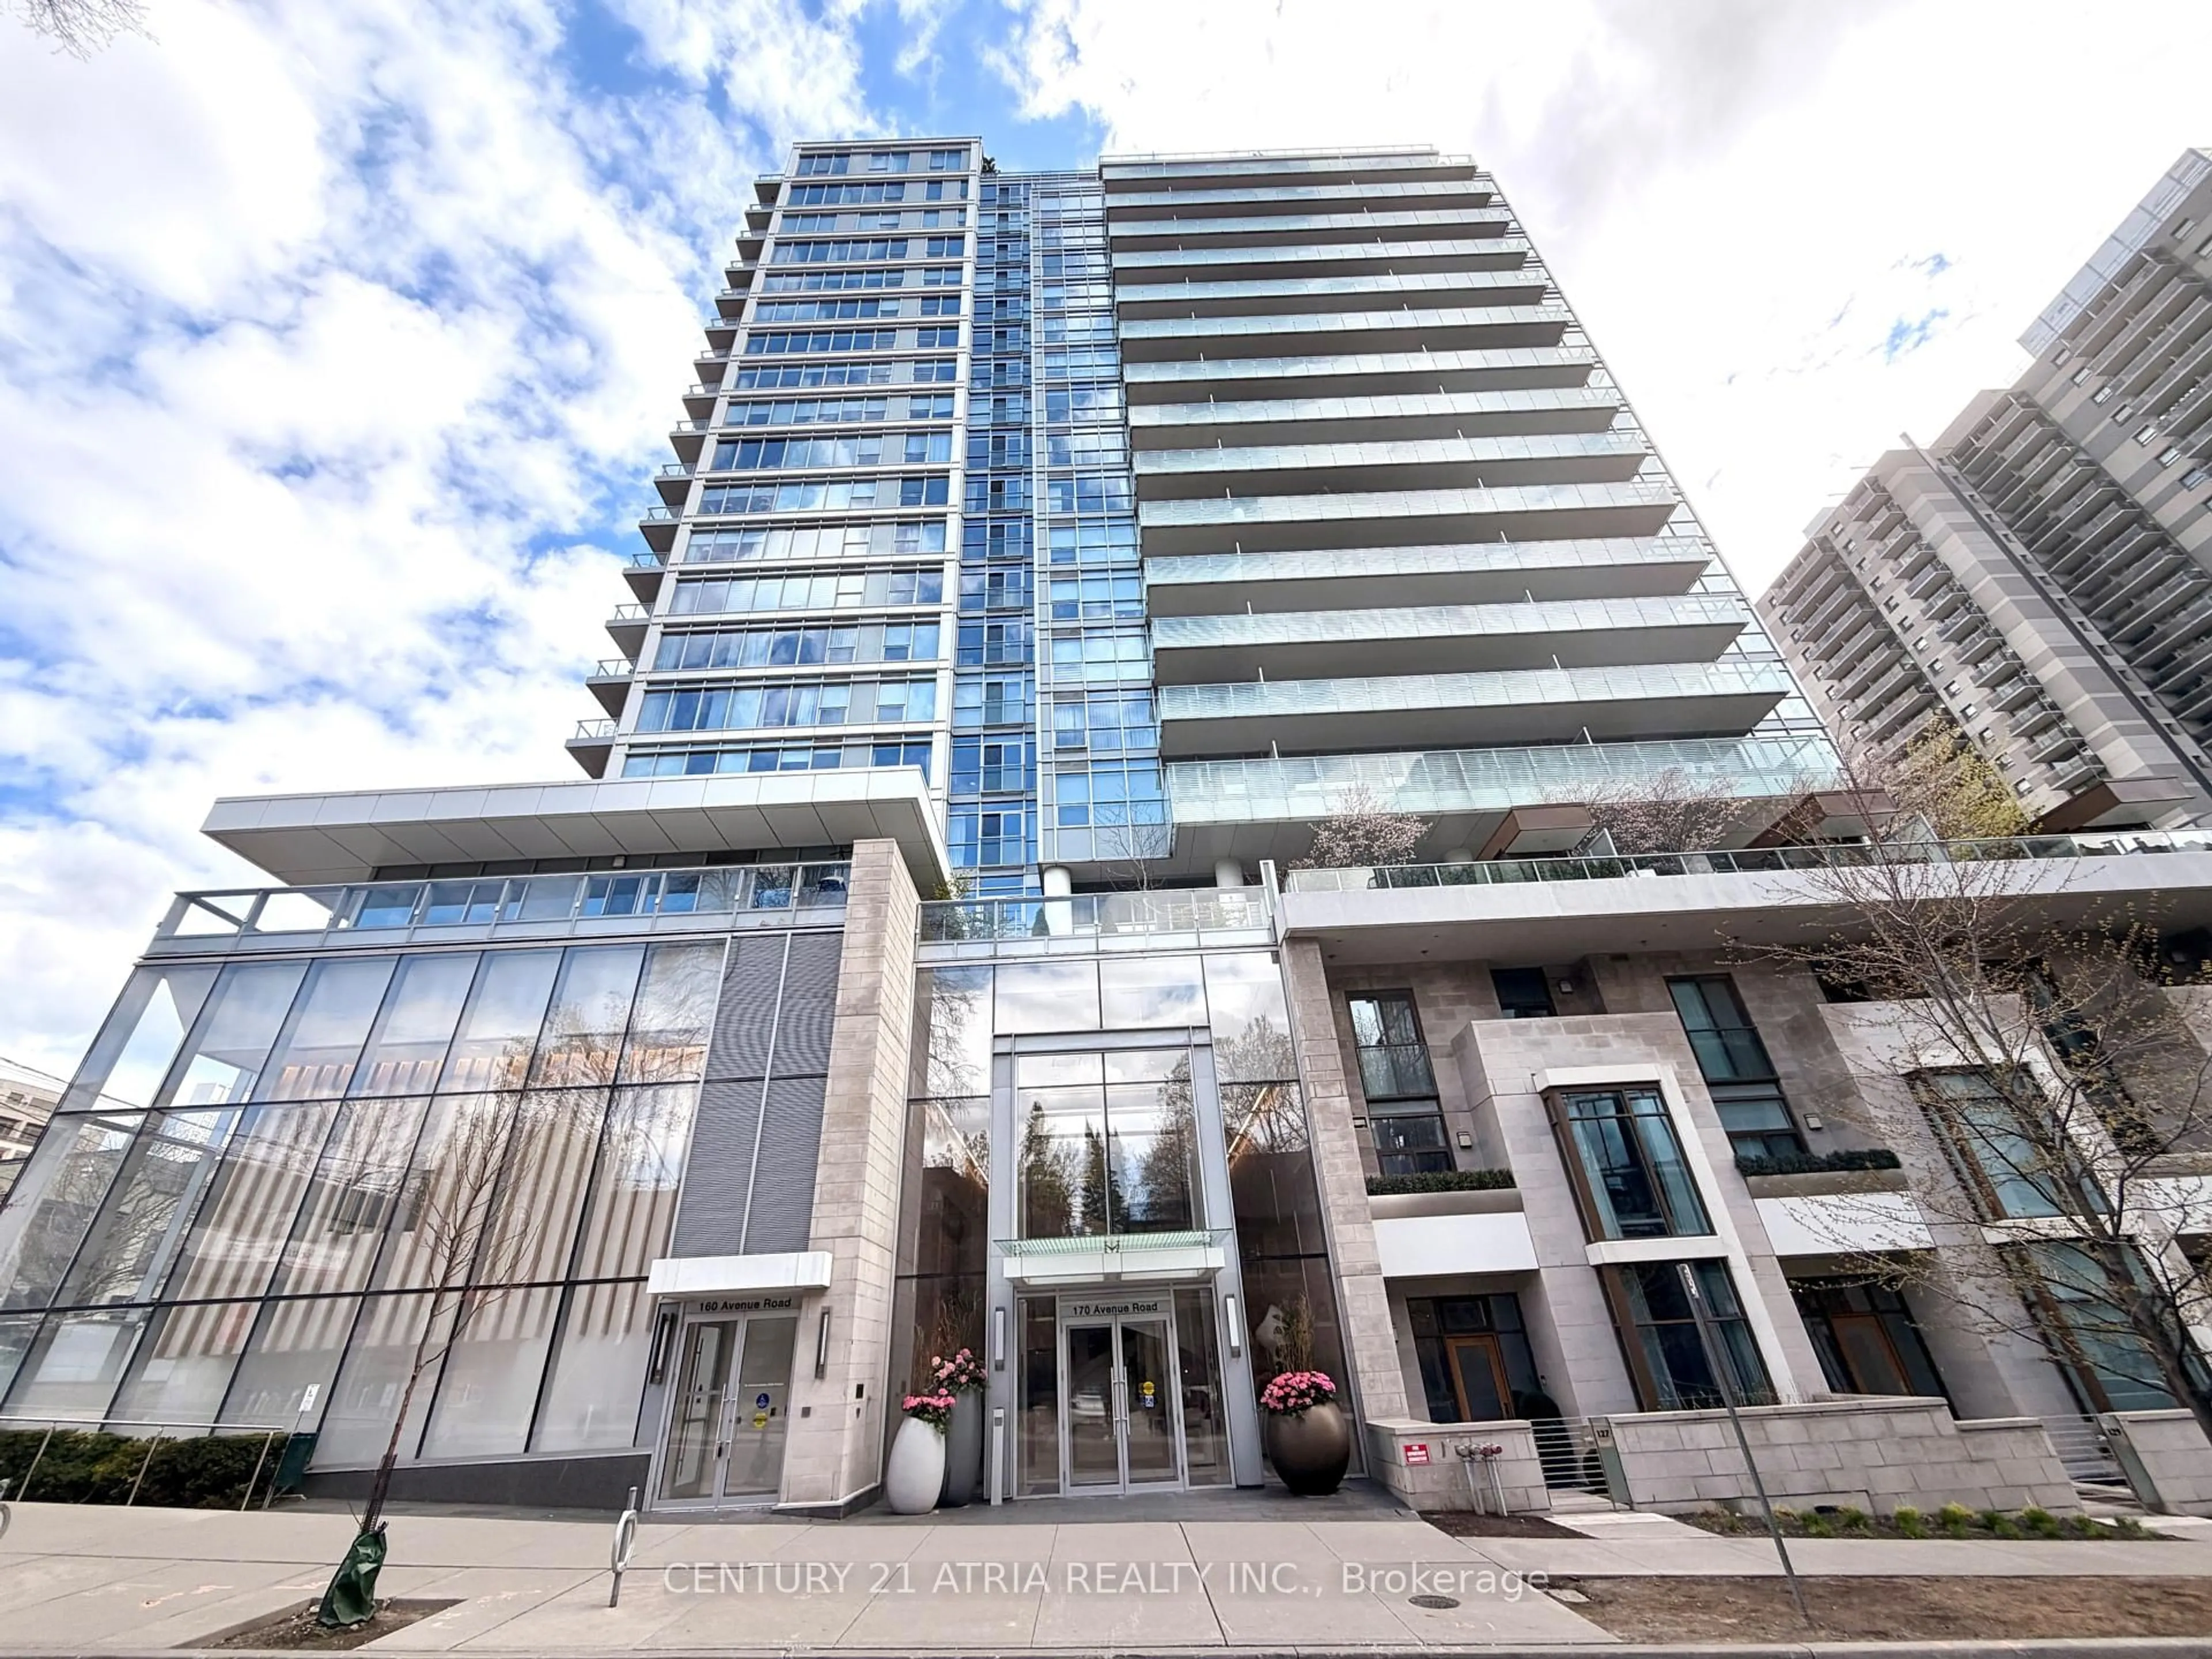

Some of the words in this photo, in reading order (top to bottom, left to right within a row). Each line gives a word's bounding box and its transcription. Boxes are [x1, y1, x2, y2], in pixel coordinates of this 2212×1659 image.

[700, 1302, 718, 1312] 160
[721, 1301, 760, 1310] Avenue
[764, 1297, 791, 1308] Road
[1074, 1305, 1090, 1315] 170
[1093, 1304, 1129, 1315] Avenue
[1132, 1302, 1157, 1312] Road
